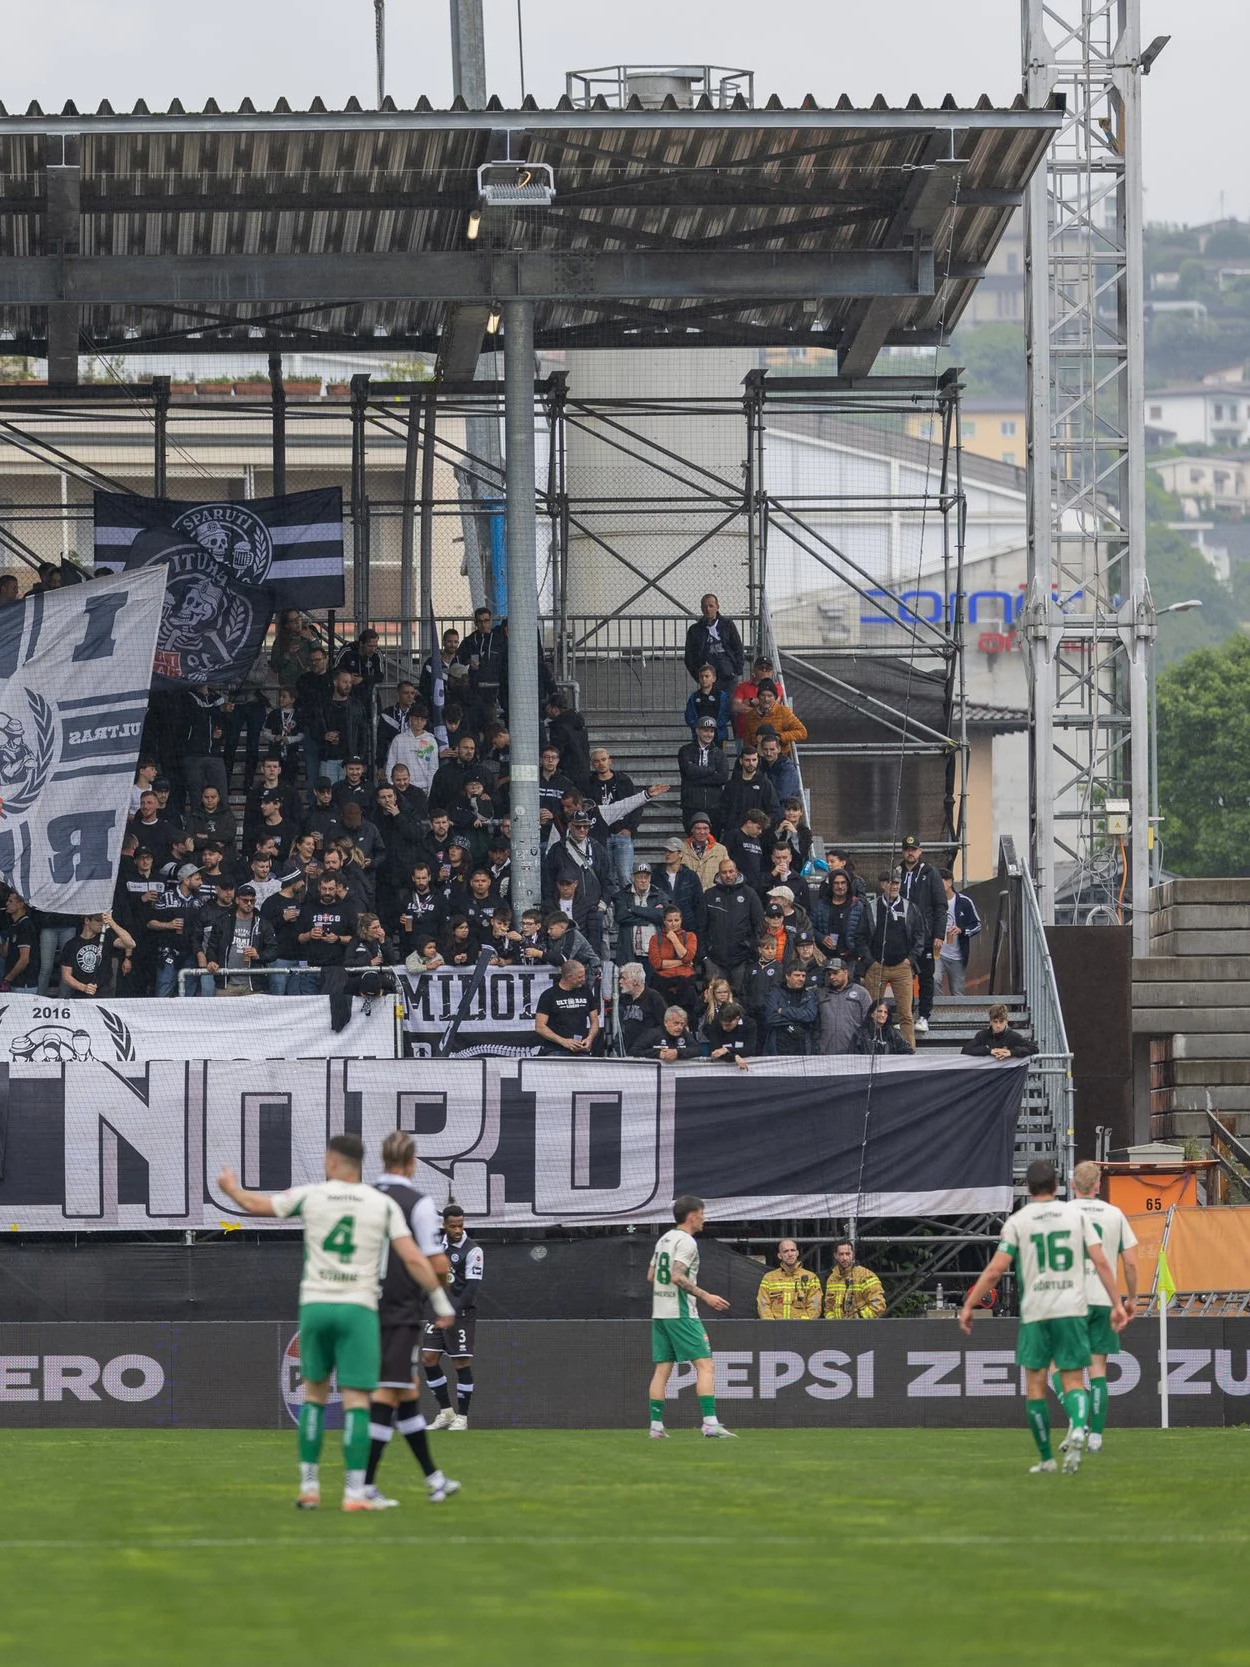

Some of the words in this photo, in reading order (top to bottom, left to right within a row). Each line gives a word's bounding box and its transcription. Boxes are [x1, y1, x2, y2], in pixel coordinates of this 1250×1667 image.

[182, 508, 254, 531] SPARUTI
[32, 1007, 71, 1020] 2016
[62, 1058, 662, 1217] NORD
[1146, 1198, 1162, 1211] 65
[323, 1215, 356, 1264] 4
[1030, 1230, 1074, 1274] 16
[458, 1329, 467, 1344] 3
[664, 1349, 875, 1400] PEPSI
[907, 1349, 1141, 1399] ZEO
